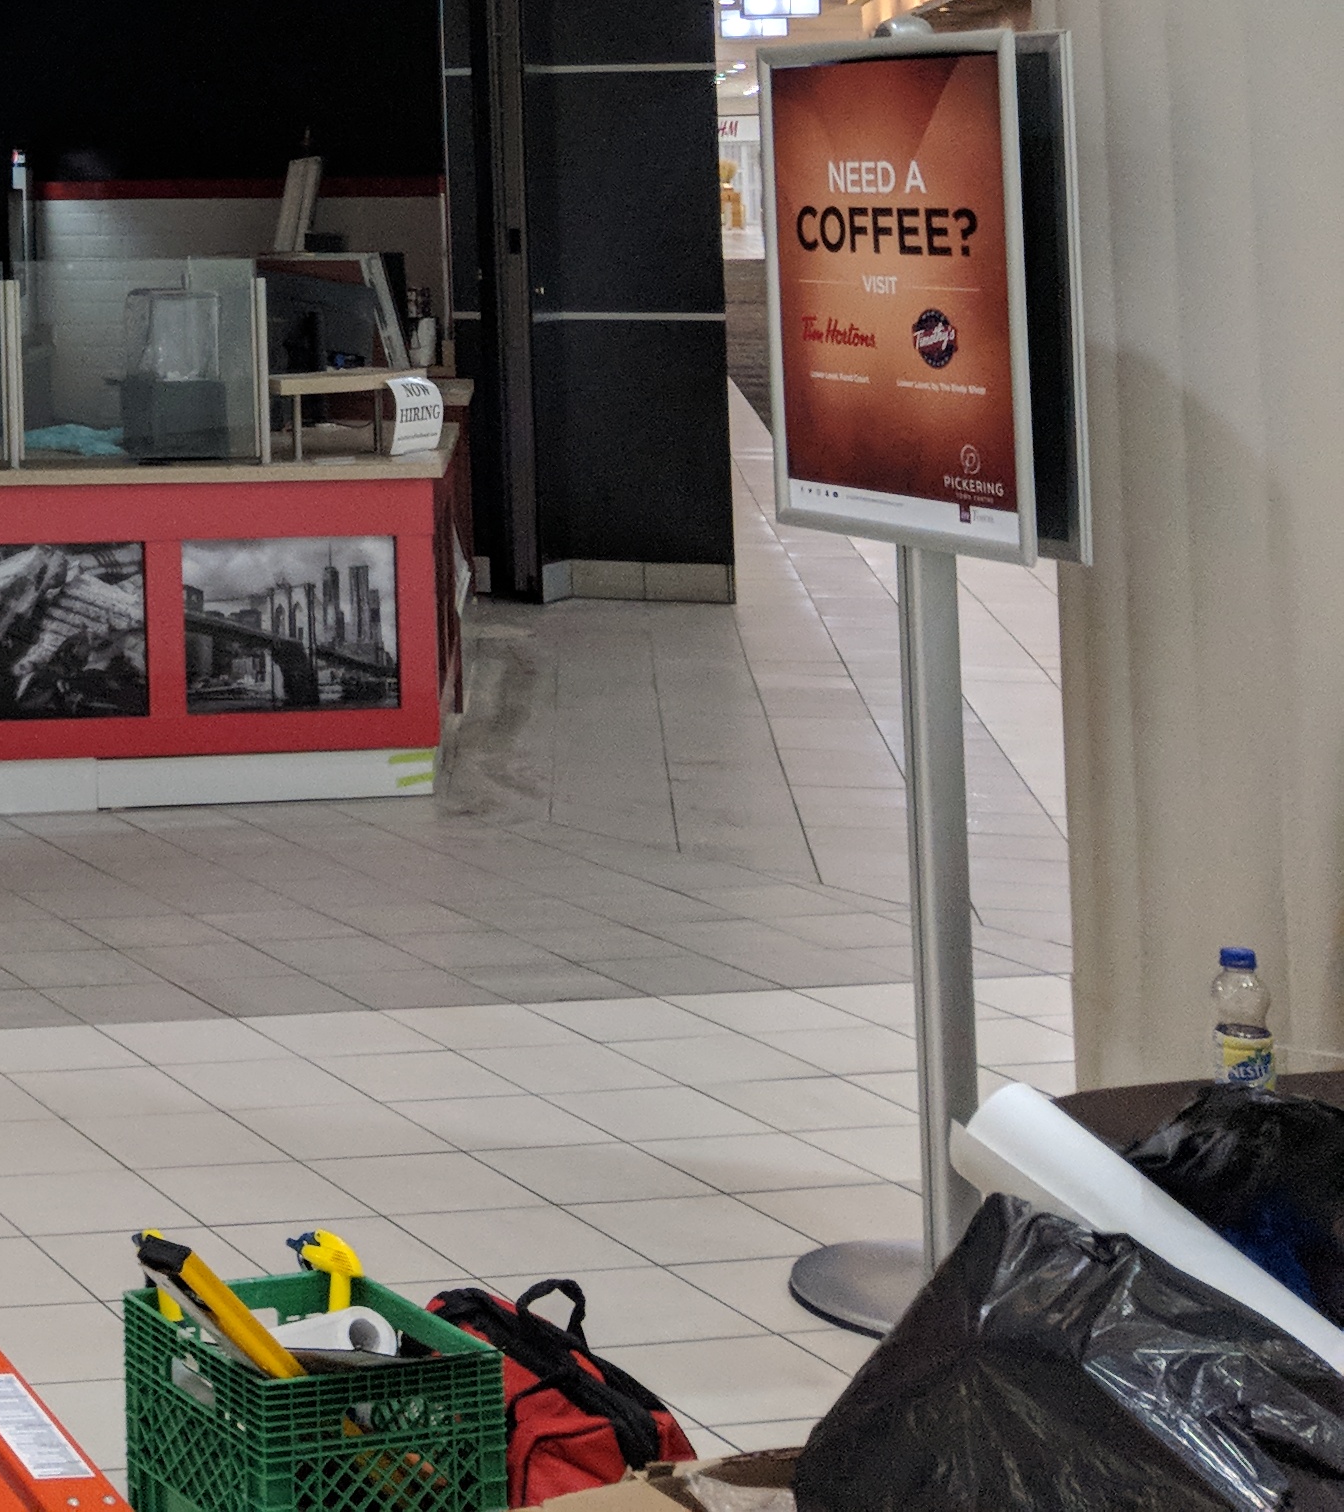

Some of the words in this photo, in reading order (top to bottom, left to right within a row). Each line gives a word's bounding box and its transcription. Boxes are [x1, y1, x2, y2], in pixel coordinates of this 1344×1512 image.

[828, 160, 896, 194] NEED
[905, 159, 927, 194] A
[796, 205, 978, 257] COFFEE?
[862, 275, 898, 295] VISIT
[801, 315, 823, 344] Tim
[824, 316, 877, 349] Hortons
[401, 383, 430, 397] NOW
[400, 405, 440, 423] HIRING
[943, 475, 1005, 497] PICKERING
